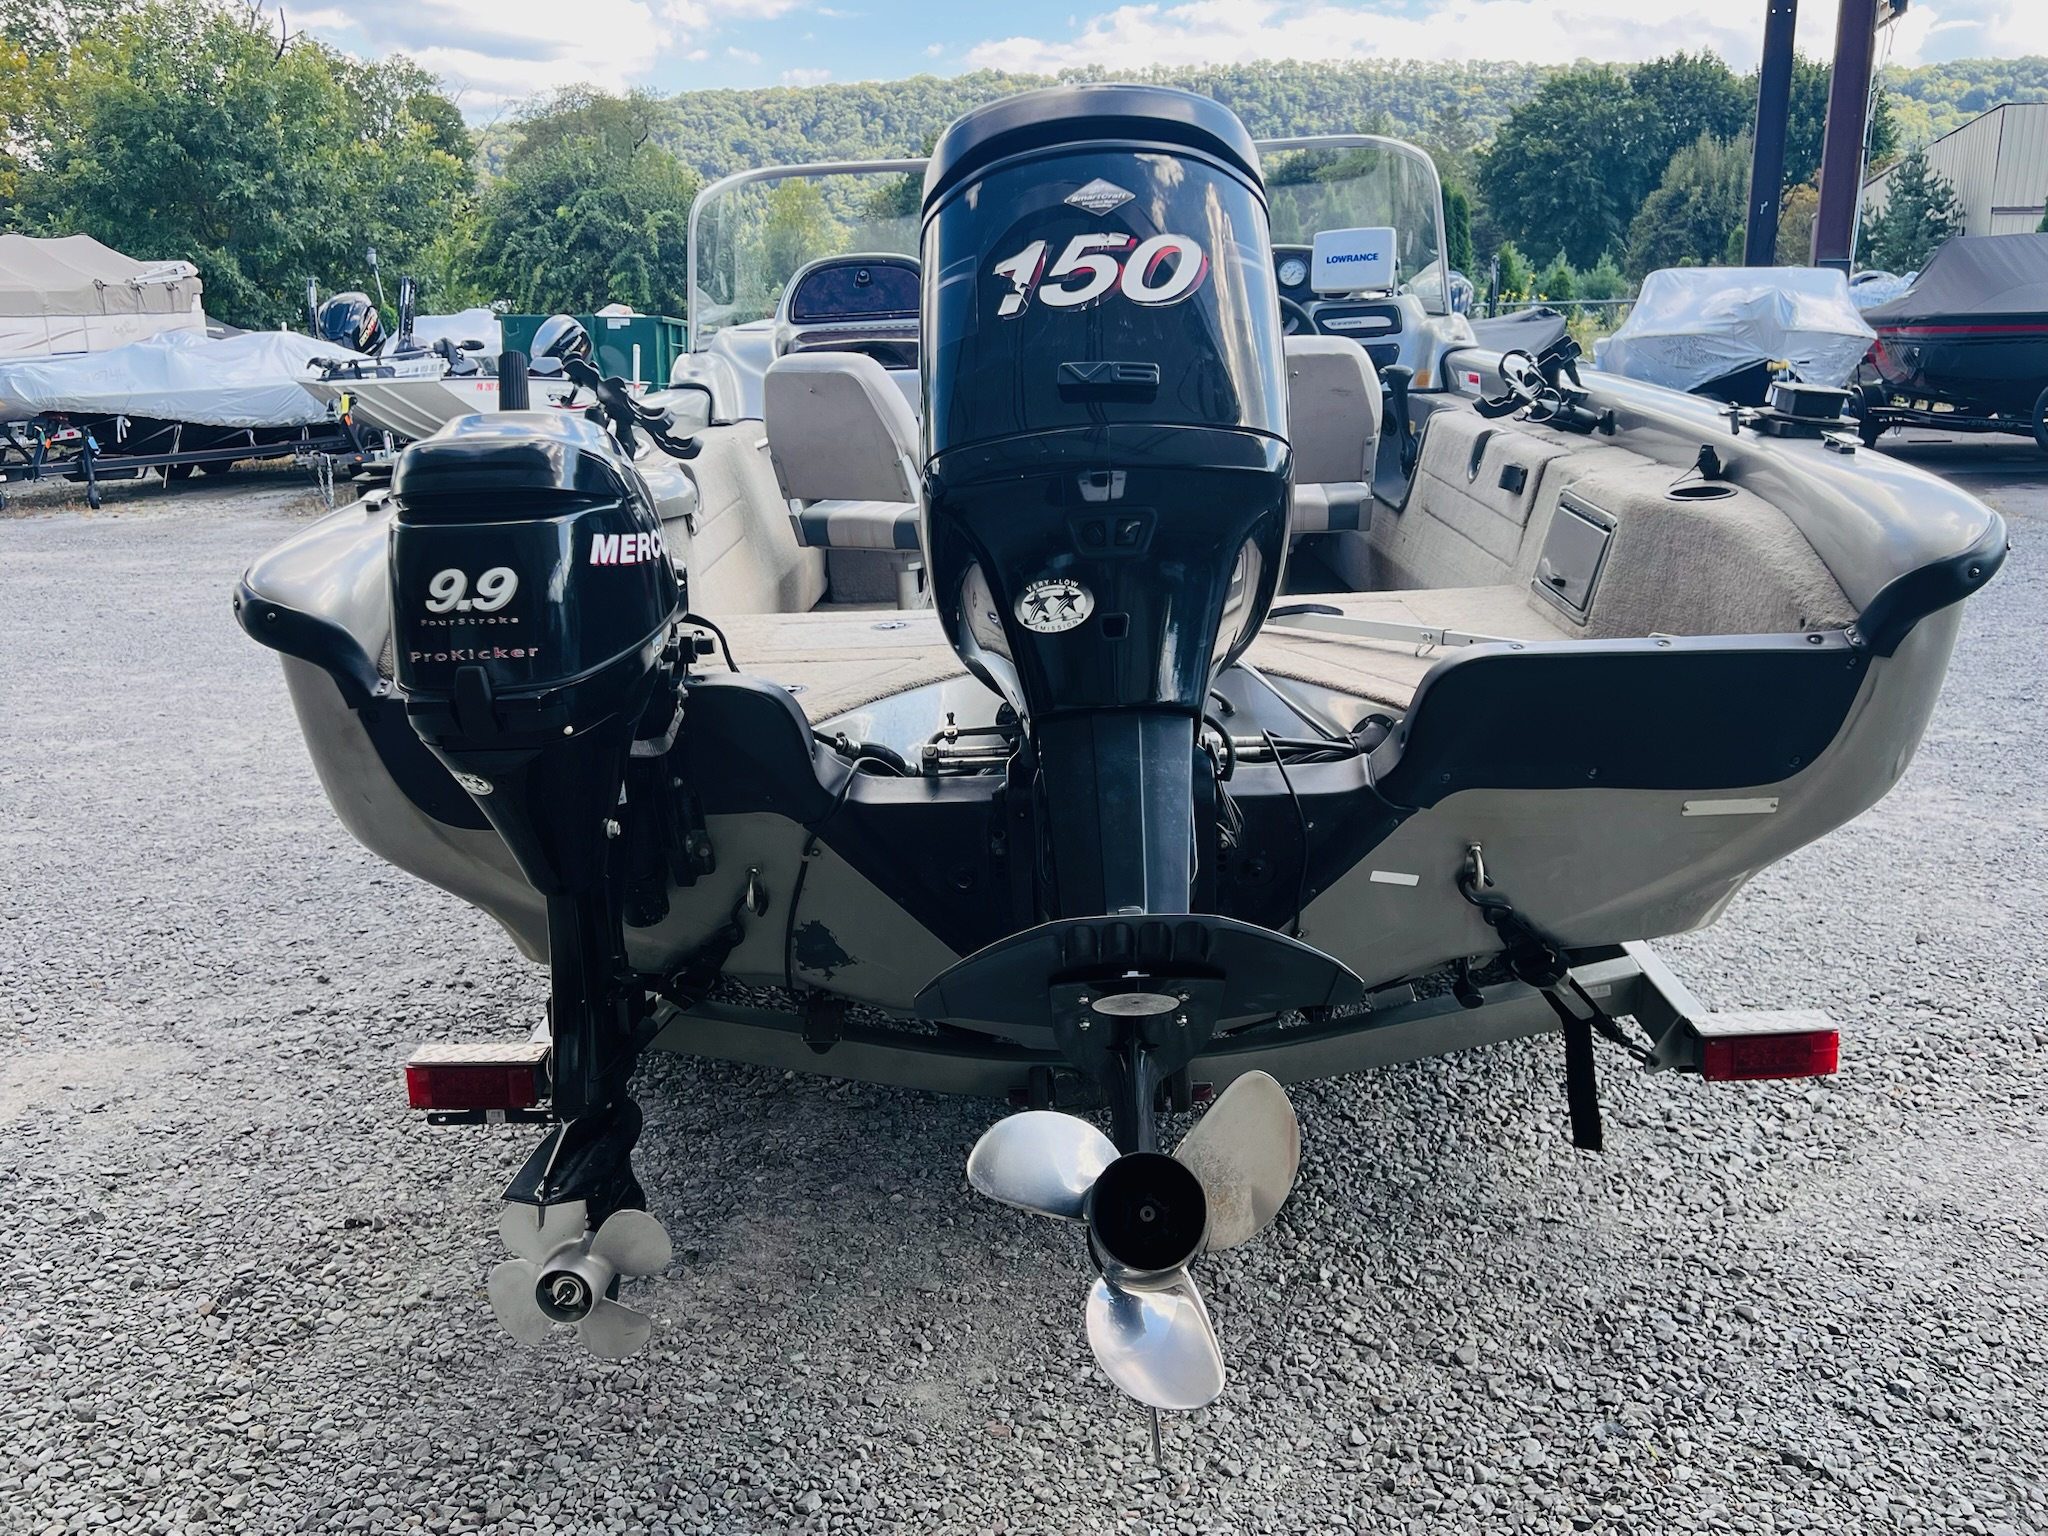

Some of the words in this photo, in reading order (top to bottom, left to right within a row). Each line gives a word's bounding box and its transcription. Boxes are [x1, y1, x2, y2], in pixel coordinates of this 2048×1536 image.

[1326, 252, 1379, 265] LOWRANCE
[993, 232, 1209, 320] 150
[1058, 361, 1160, 385] V6
[425, 566, 519, 614] 9.9
[1026, 580, 1049, 593] VERY
[1059, 579, 1079, 588] LOW
[420, 616, 519, 627] FourStroke
[1035, 620, 1078, 631] EMISSION
[410, 647, 539, 663] ProKicker
